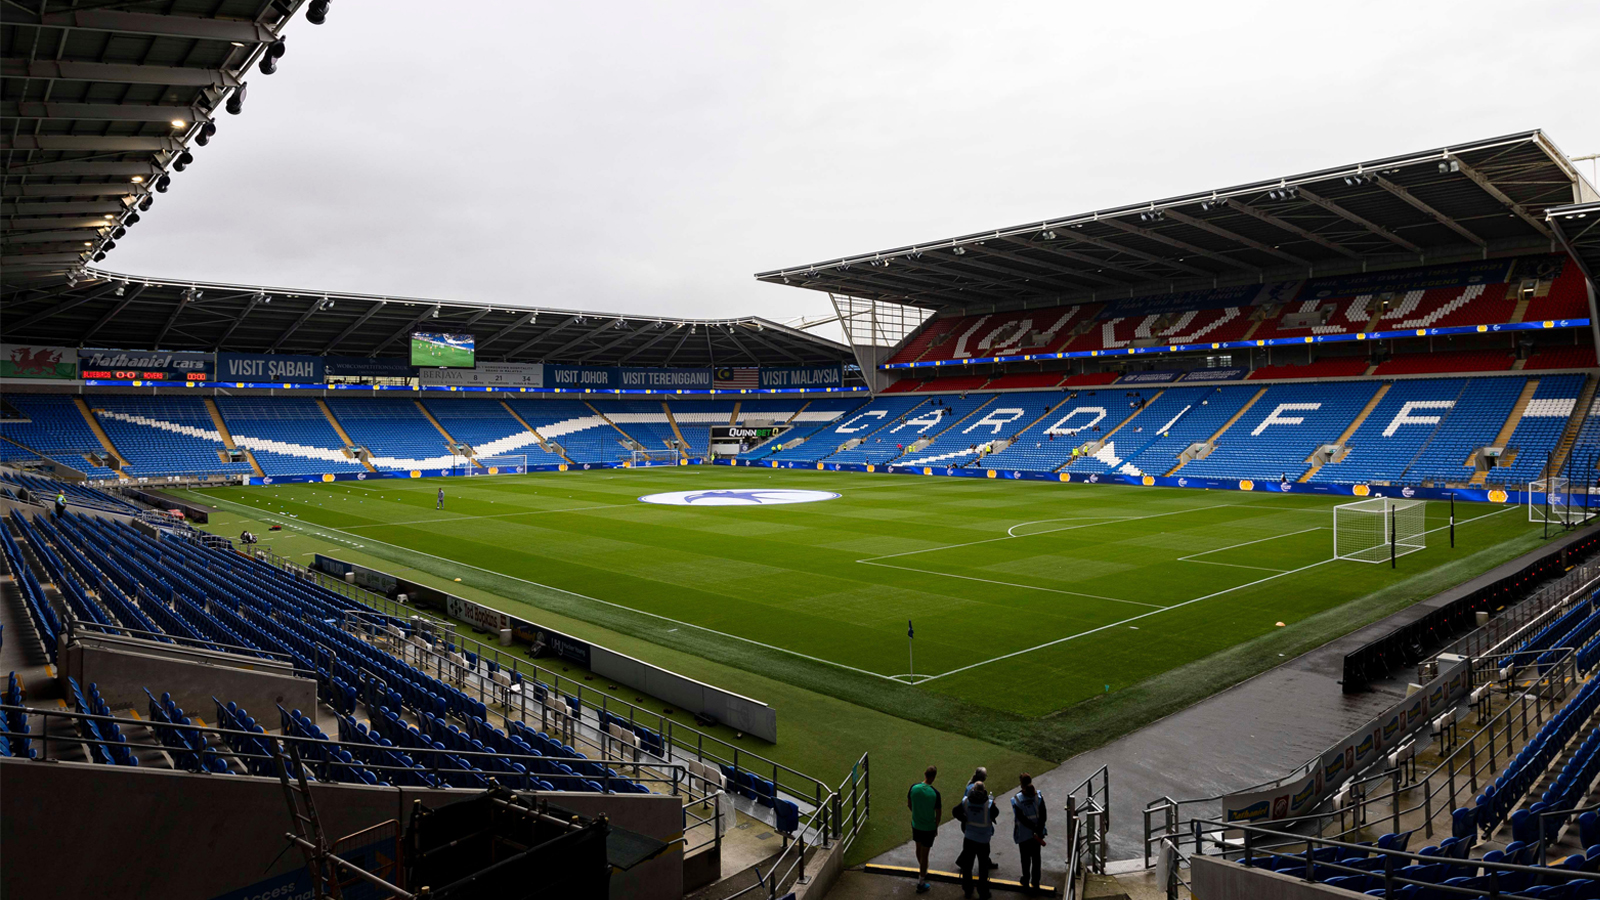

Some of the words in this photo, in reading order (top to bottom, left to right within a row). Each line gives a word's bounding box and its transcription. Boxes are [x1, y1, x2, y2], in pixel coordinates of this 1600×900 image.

[1384, 283, 1410, 291] CITY
[1412, 278, 1459, 288] LEGEND
[172, 359, 205, 369] cars
[229, 359, 265, 376] VISIT
[268, 360, 314, 377] SABAH
[82, 370, 112, 379] BLUEBIRDS
[143, 372, 163, 380] ROVERS
[423, 370, 463, 379] BERJAYA
[554, 369, 579, 383] VISIT
[580, 370, 608, 384] JOHOR
[622, 371, 647, 384] VISIT
[647, 372, 710, 385] TERENGGANU
[762, 370, 789, 386] VISIT
[790, 368, 839, 385] MALAYSIA
[835, 400, 1457, 437] CARDIFF
[464, 603, 474, 620] Ted
[474, 606, 498, 629] Hopkins
[1231, 805, 1268, 821] Nathaniel
